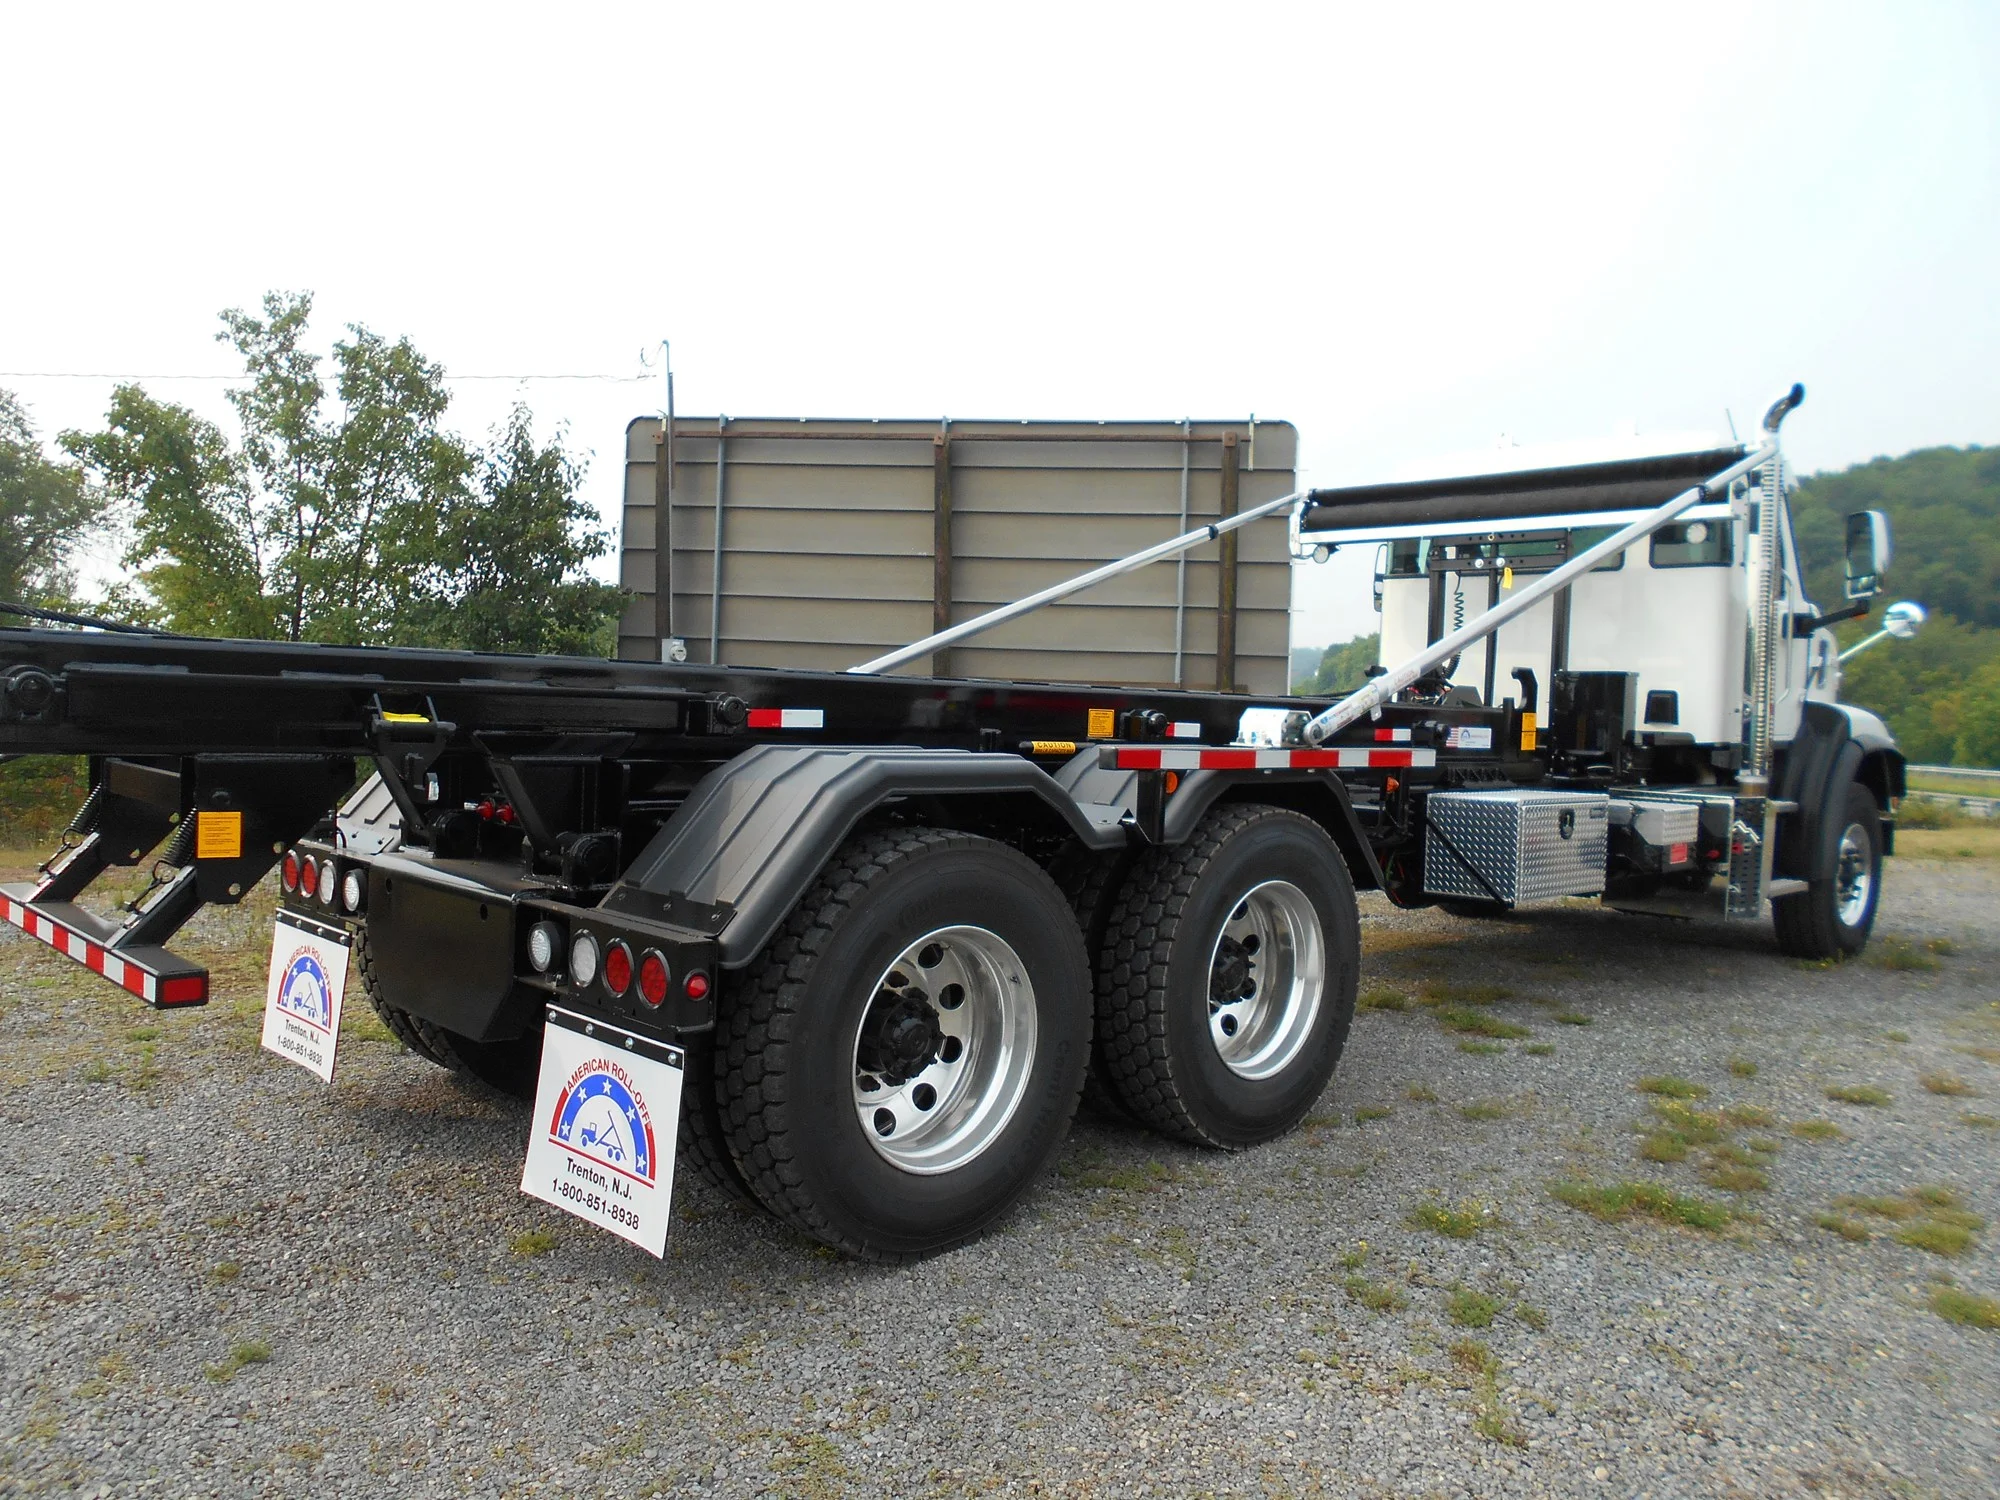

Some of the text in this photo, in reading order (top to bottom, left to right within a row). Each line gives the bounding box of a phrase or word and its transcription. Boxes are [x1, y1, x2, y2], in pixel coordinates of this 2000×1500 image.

[286, 945, 331, 992] AMERICAN ROLL-OFF
[278, 1035, 322, 1066] 1-800-851-8938
[286, 1019, 320, 1045] Trenton, N.J.
[567, 1058, 650, 1121] AMERICAN ROLL-OFF
[567, 1157, 632, 1200] Trenton, N.J.
[552, 1178, 639, 1230] 1-800-851-8938
